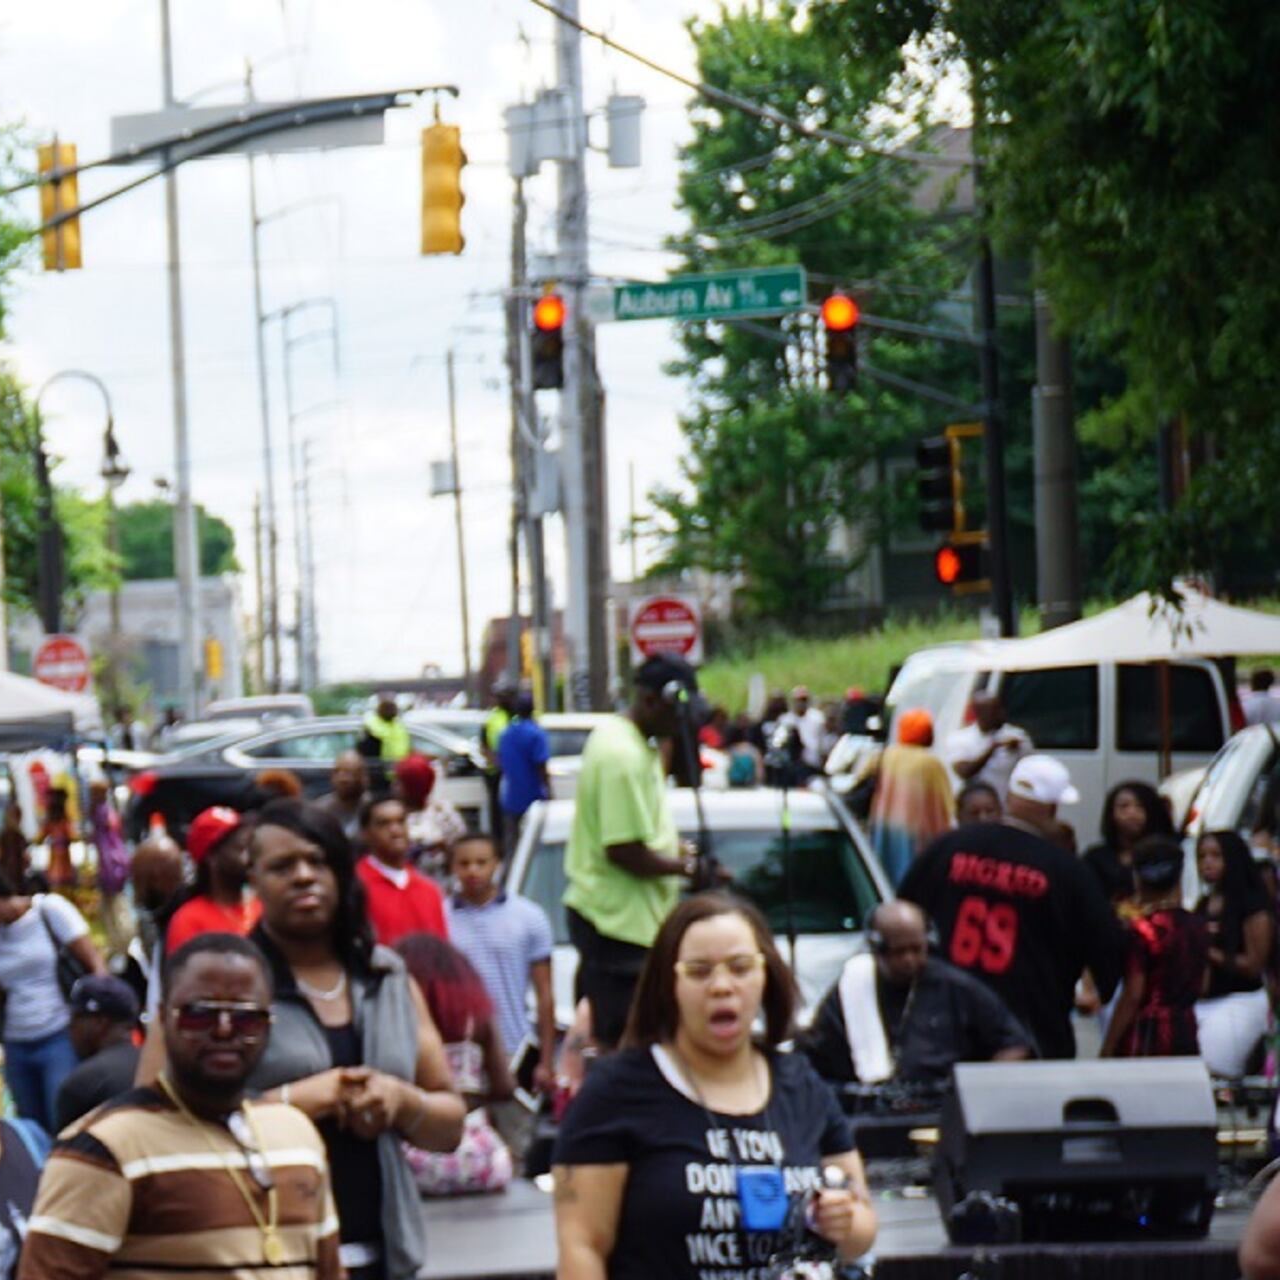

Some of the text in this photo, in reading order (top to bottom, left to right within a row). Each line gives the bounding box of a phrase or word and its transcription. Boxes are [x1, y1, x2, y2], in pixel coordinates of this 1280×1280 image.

[949, 895, 1019, 974] 69
[706, 1128, 784, 1162] IF YOU
[784, 1165, 822, 1194] AVE
[686, 1232, 741, 1266] NICE
